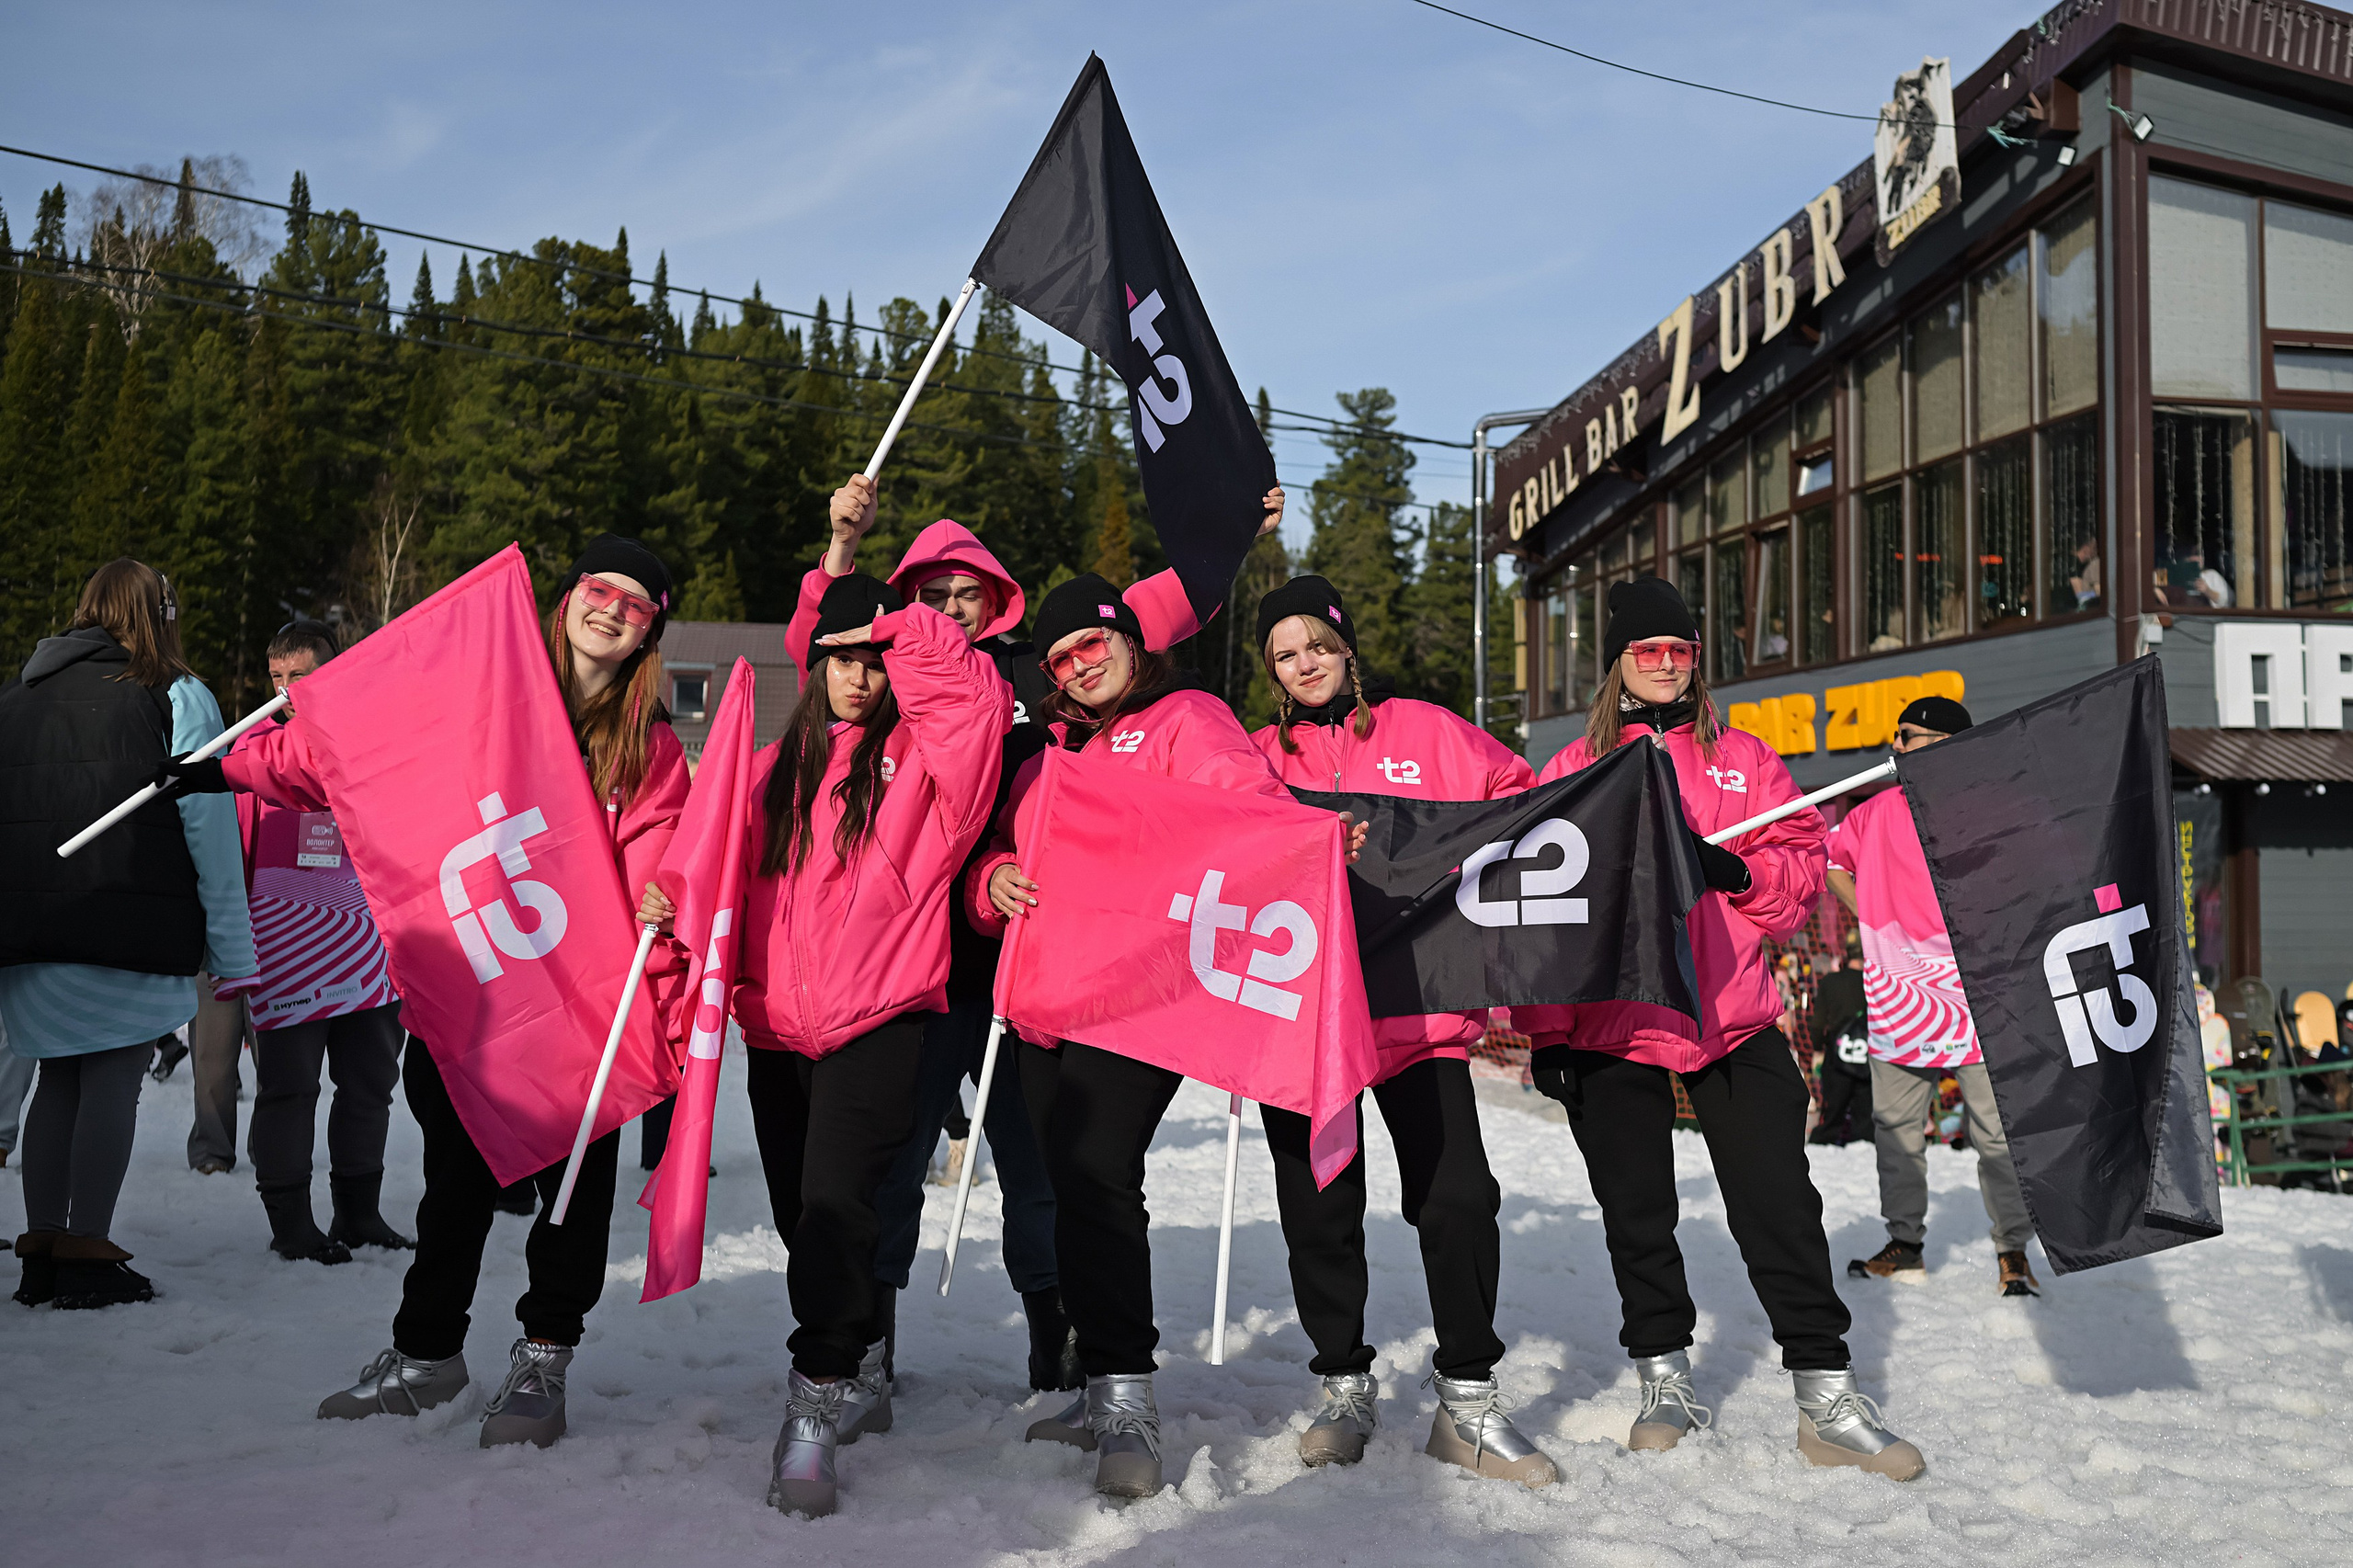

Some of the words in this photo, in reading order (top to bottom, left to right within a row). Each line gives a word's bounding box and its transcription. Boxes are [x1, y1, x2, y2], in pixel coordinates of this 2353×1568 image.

[1886, 185, 1943, 251] ZUBR
[1508, 445, 1579, 542] GRILL
[1586, 385, 1639, 474] BAR
[1657, 185, 1847, 447] ZUBR
[1102, 607, 1113, 616] t2
[1012, 700, 1030, 725] 2
[1110, 730, 1145, 753] t2
[1376, 756, 1422, 785] t2
[1705, 765, 1747, 793] t2
[306, 837, 335, 846] ВОЛОНТЕР
[438, 791, 568, 984] t2
[1167, 869, 1319, 1022] t2
[2043, 882, 2158, 1069] t2
[326, 986, 358, 999] INVITRO
[1836, 1033, 1869, 1064] t2
